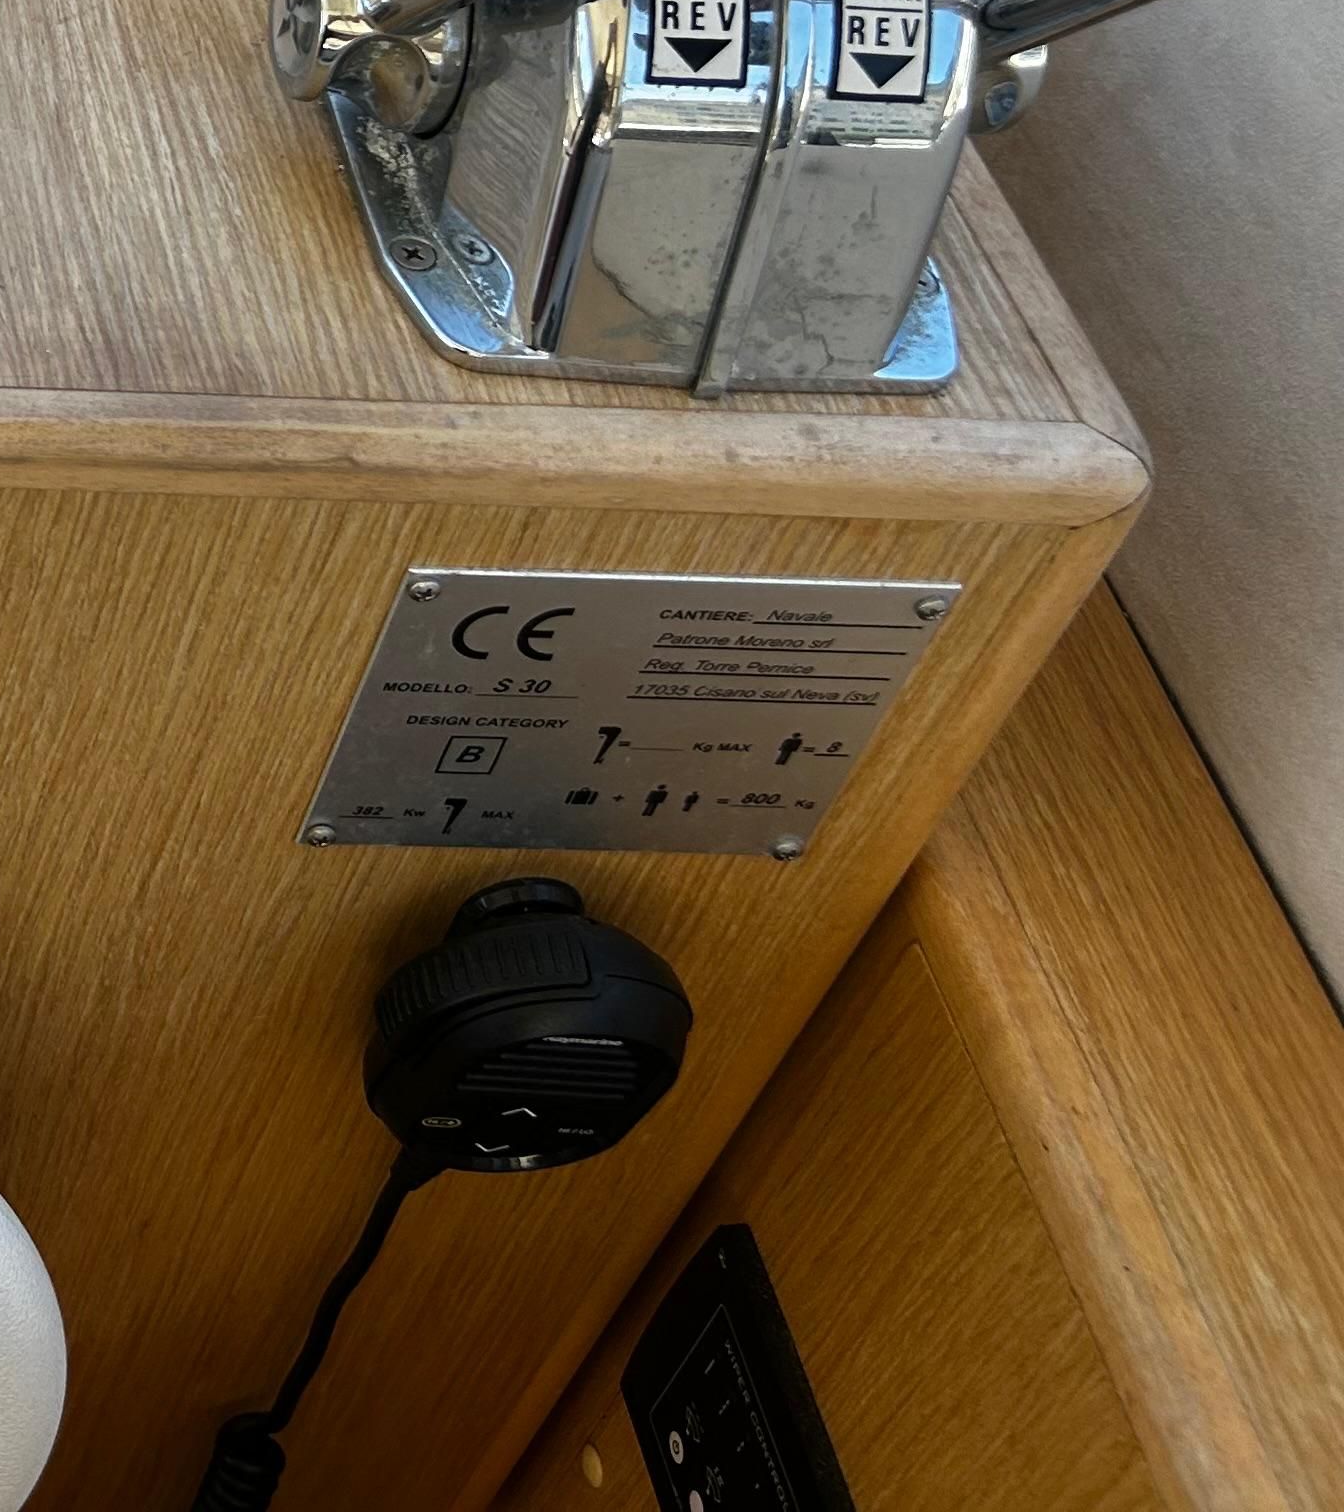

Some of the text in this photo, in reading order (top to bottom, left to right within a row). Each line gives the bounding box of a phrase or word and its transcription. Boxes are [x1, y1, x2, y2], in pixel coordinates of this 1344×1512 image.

[660, 0, 737, 32] REV
[846, 15, 921, 49] REV
[659, 609, 834, 624] CANTIERE: Navale
[451, 606, 576, 662] CE
[656, 632, 731, 646] Patrone
[734, 635, 805, 648] Moreno
[696, 659, 741, 672] Torre
[493, 678, 514, 694] S
[518, 679, 552, 694] 30
[633, 684, 689, 697] 17035
[694, 685, 756, 699] Cisano
[760, 687, 787, 699] sul
[791, 689, 841, 702] Neva
[406, 714, 570, 729] DESIGN CATEGORY
[455, 745, 485, 764] B
[716, 743, 753, 753] MAX
[826, 741, 843, 754] 8
[741, 793, 782, 805] 800
[352, 806, 385, 816] 382
[481, 810, 515, 820] MAX
